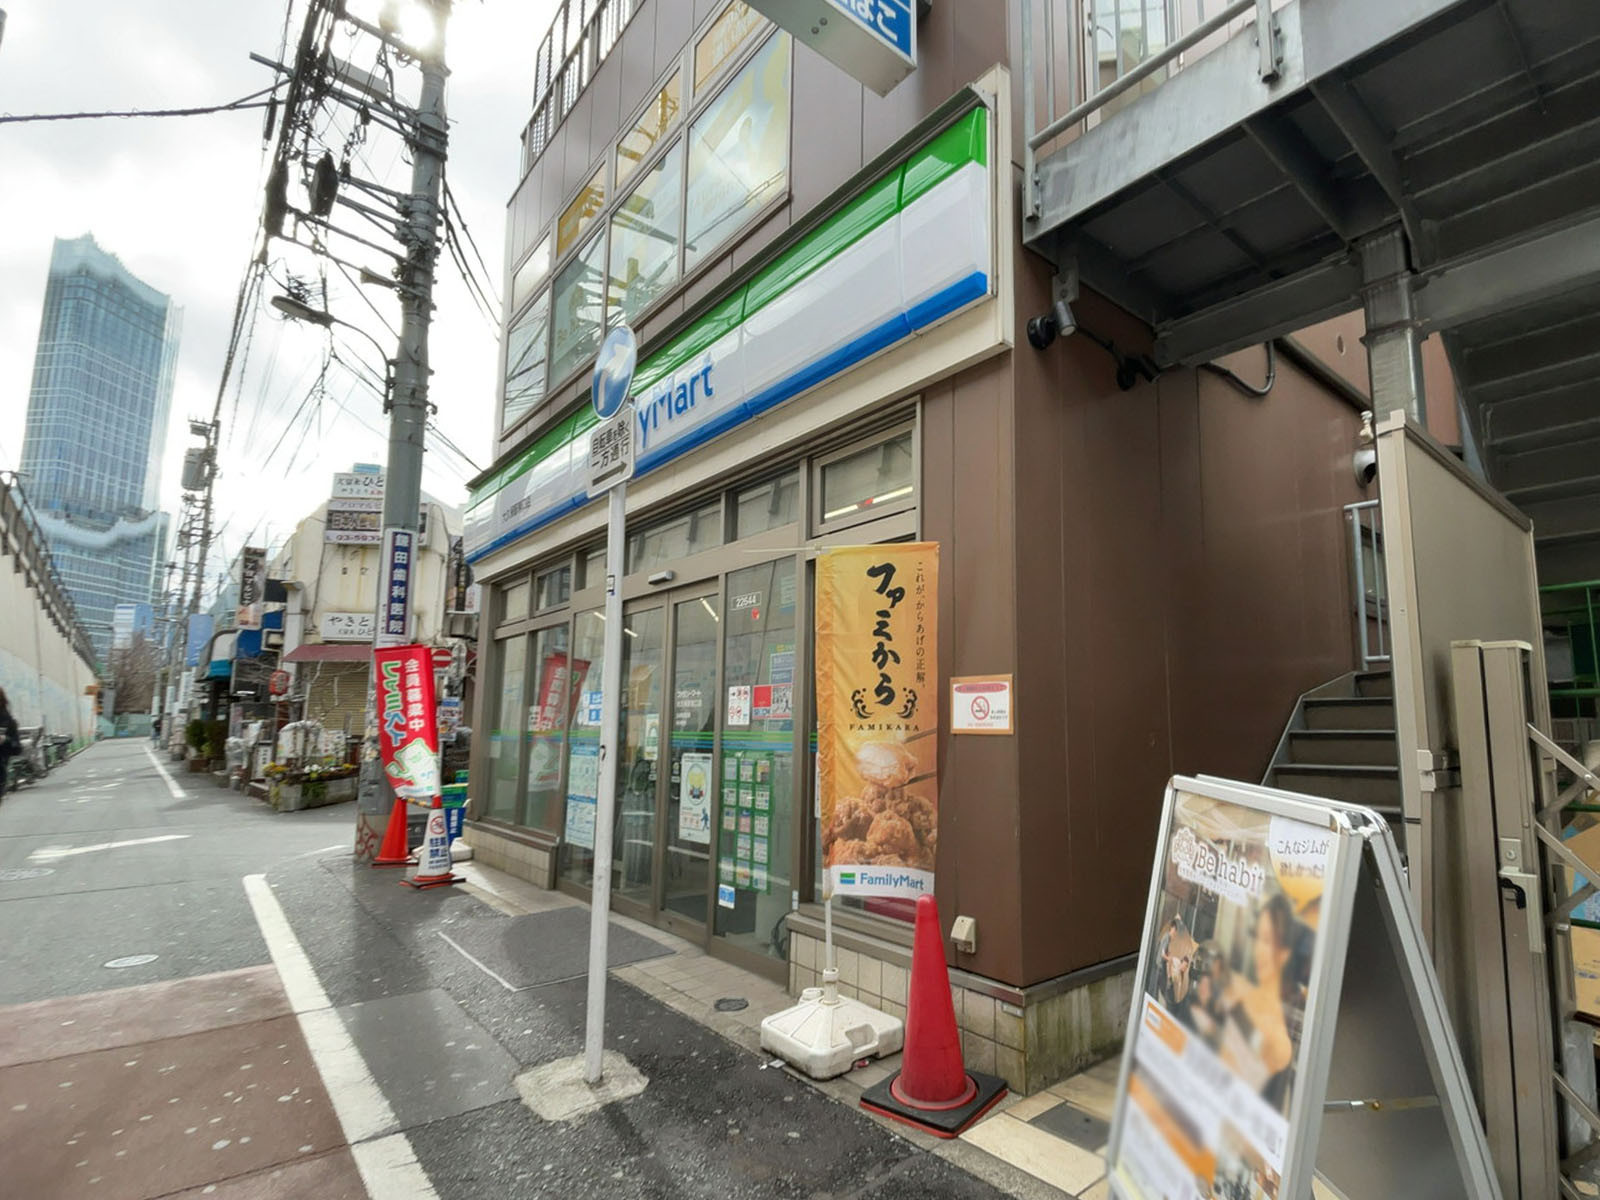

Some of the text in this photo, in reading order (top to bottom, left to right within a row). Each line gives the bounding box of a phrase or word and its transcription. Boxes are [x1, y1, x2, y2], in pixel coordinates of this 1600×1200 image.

[592, 436, 630, 469] 一方通行
[867, 562, 906, 706] ファミから
[849, 723, 920, 731] FAMIKARA
[1277, 839, 1330, 855] こんなジムが
[860, 872, 924, 890] FamilyMart
